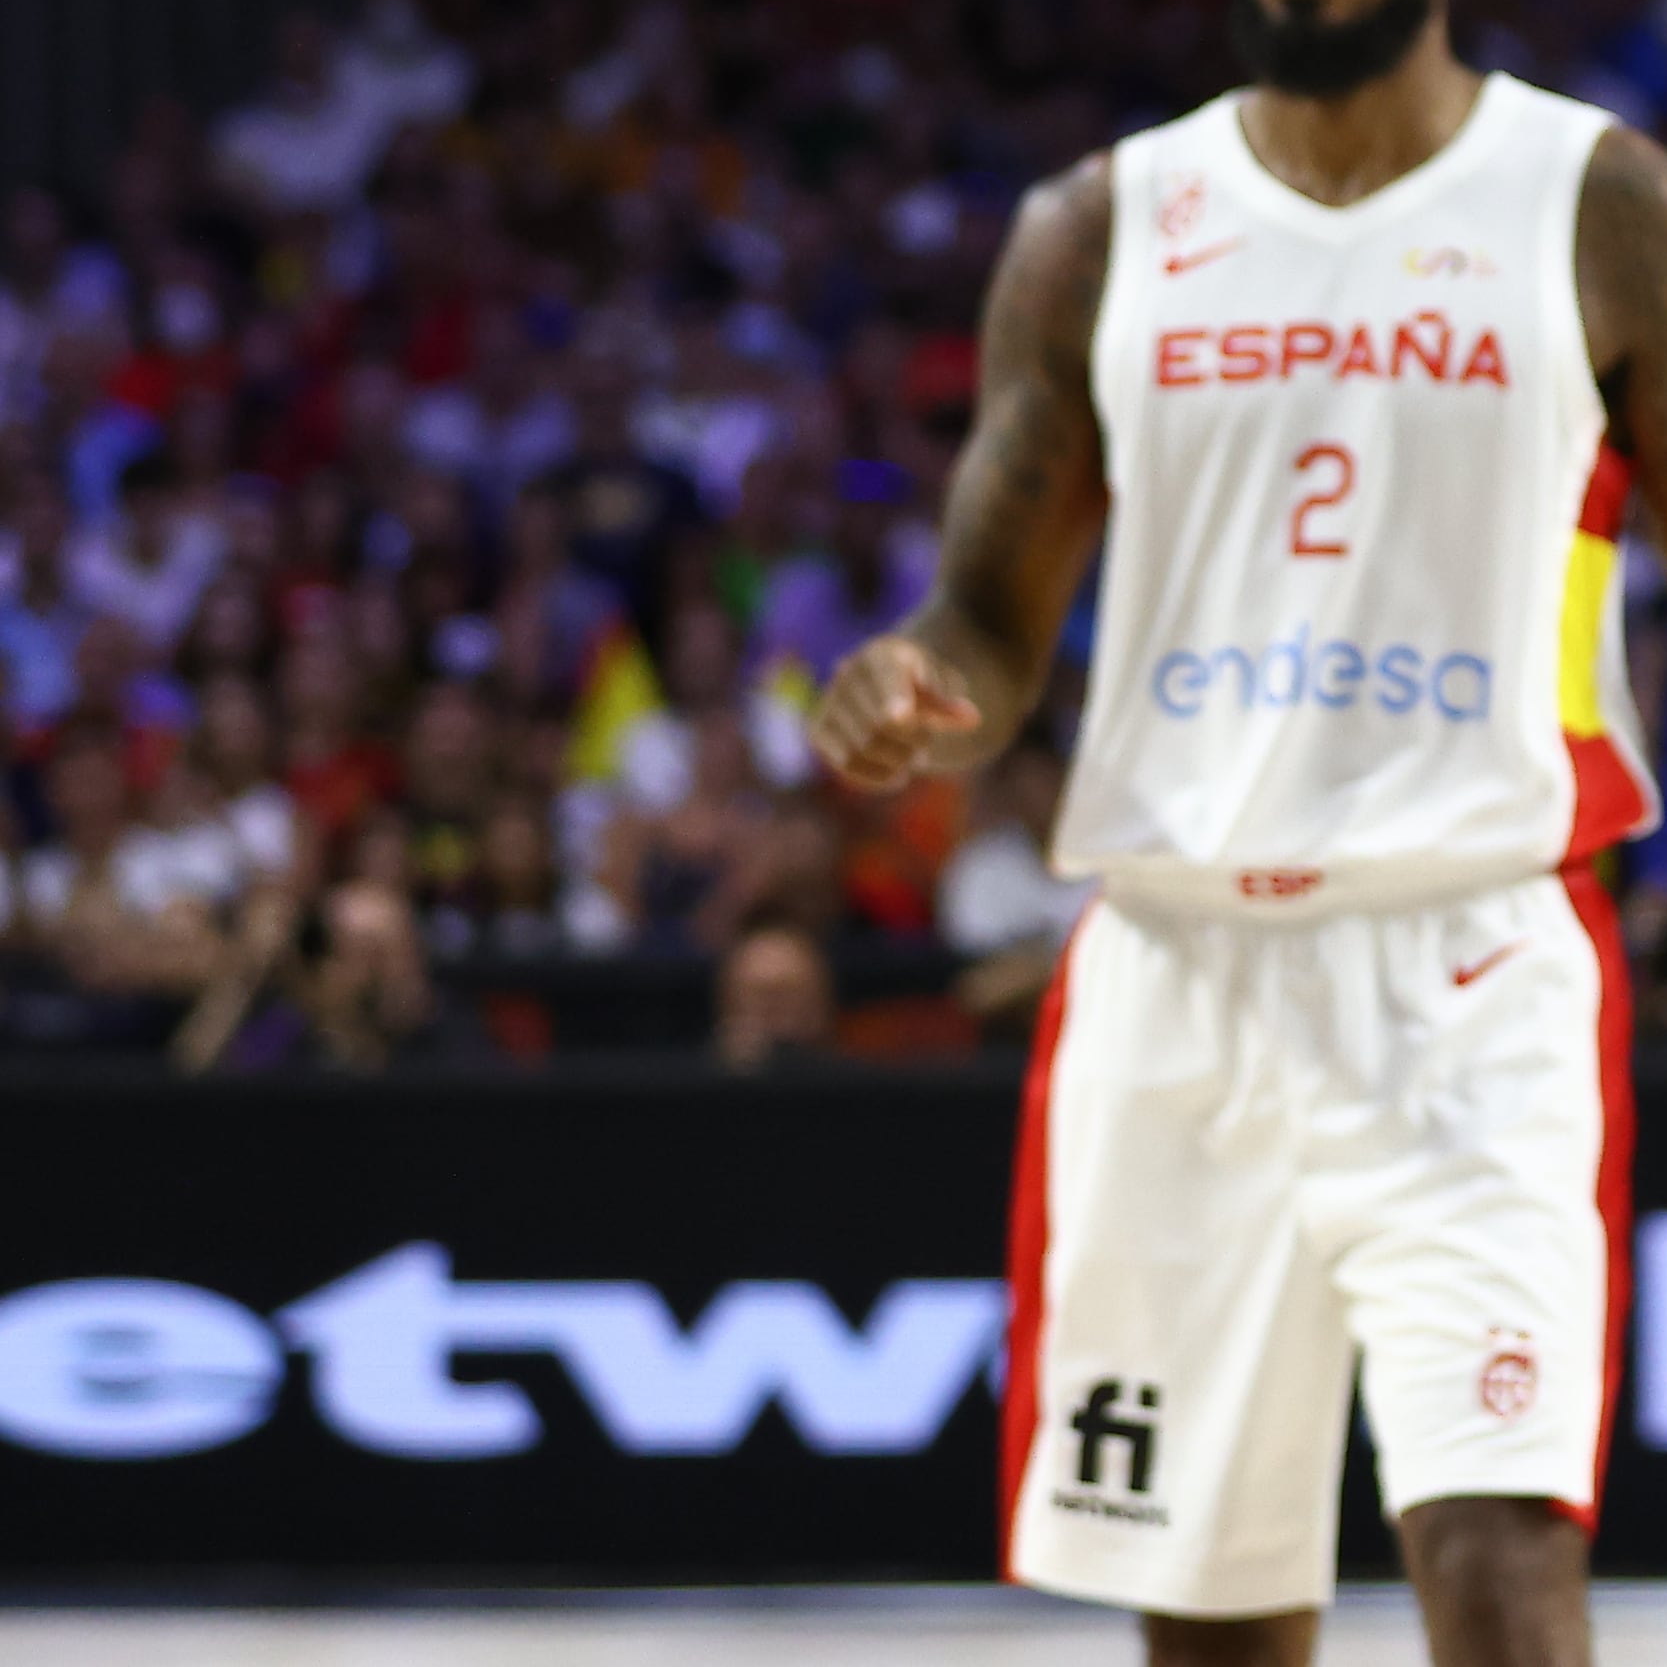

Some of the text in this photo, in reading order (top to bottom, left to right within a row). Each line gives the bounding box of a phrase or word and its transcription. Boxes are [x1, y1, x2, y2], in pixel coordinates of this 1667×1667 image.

[1154, 309, 1511, 390] ESPAÑA
[1289, 442, 1356, 559] 2
[1152, 624, 1494, 723] endesa
